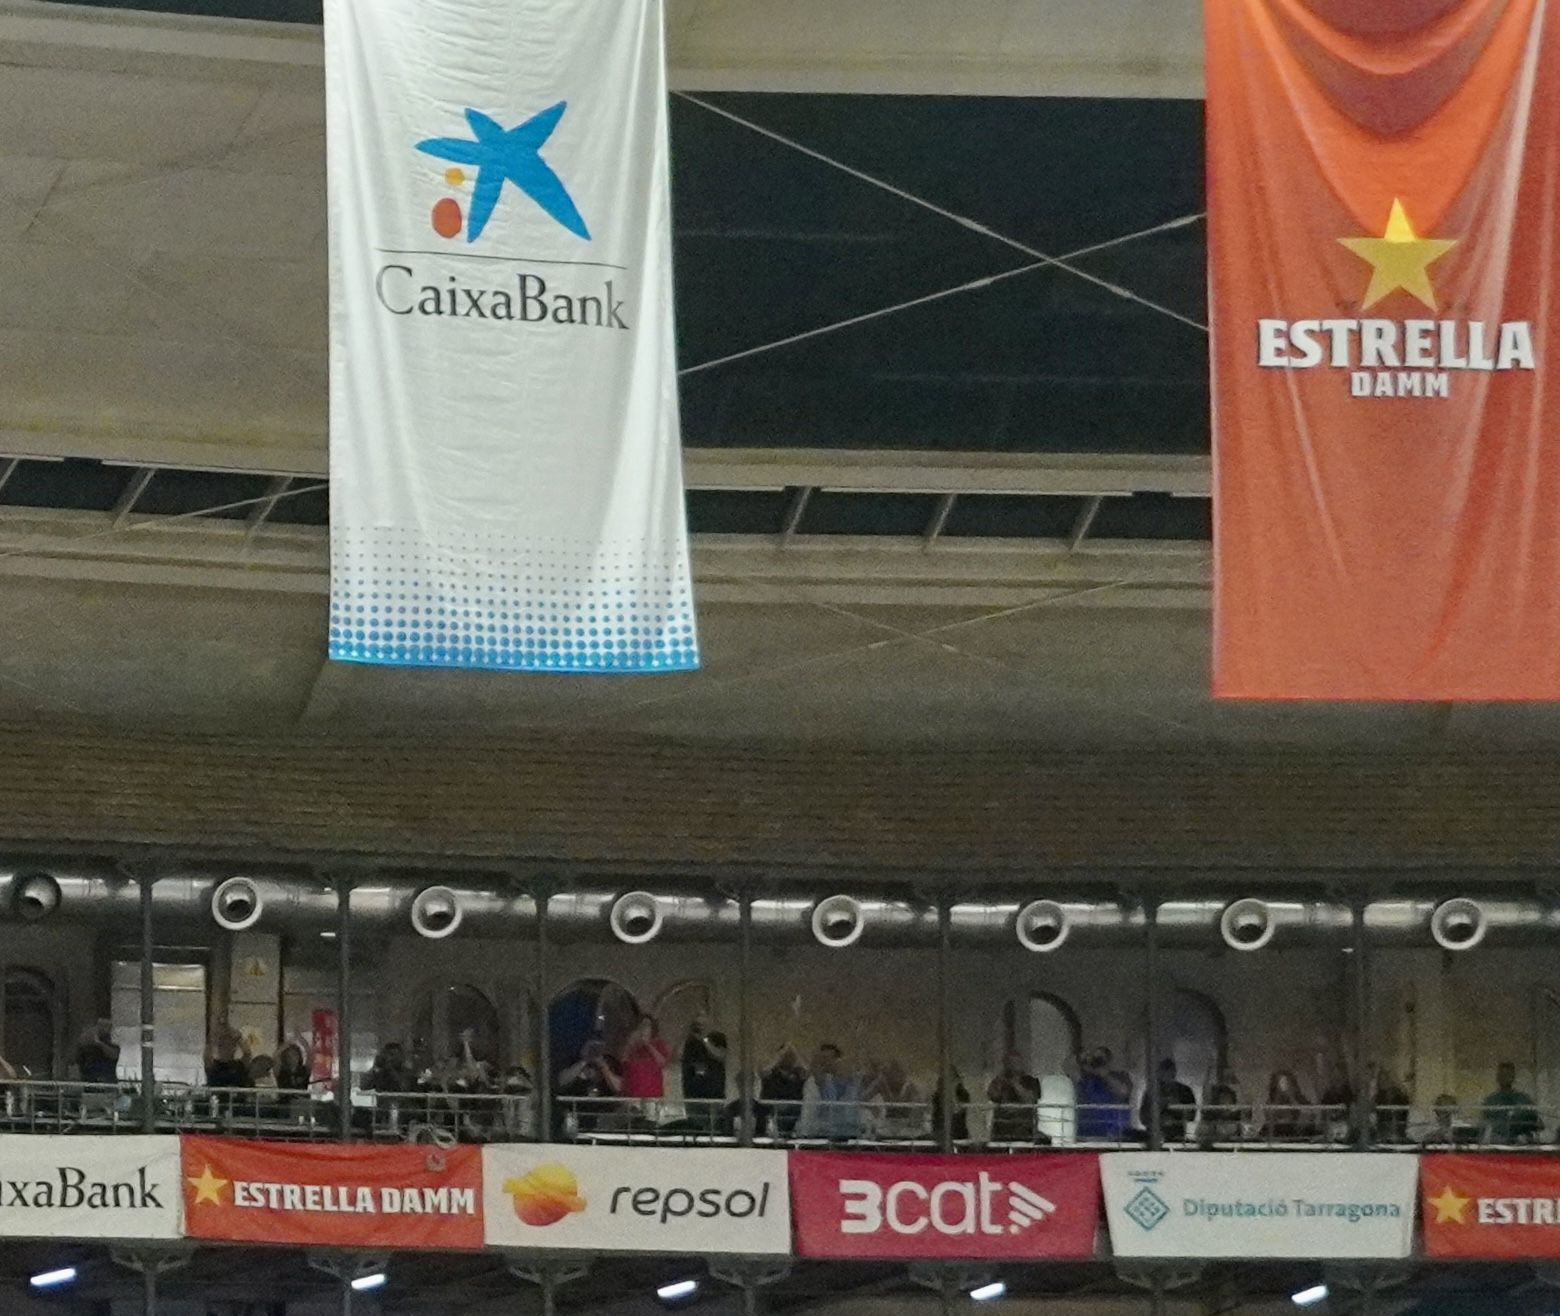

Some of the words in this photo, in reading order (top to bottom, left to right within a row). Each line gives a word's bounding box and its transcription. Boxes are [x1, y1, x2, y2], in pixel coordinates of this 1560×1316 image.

[375, 265, 630, 330] CaixaBank
[1257, 319, 1536, 371] ESTRELLA
[1350, 371, 1450, 397] DAMM
[233, 1179, 376, 1214] ESTRELLA
[381, 1186, 476, 1216] DAMM
[609, 1181, 769, 1223] repsol
[838, 1171, 1004, 1235] 3cat
[1182, 1199, 1287, 1221] Diputació
[1294, 1199, 1401, 1222] Tarragona
[1478, 1197, 1560, 1225] ESTR
